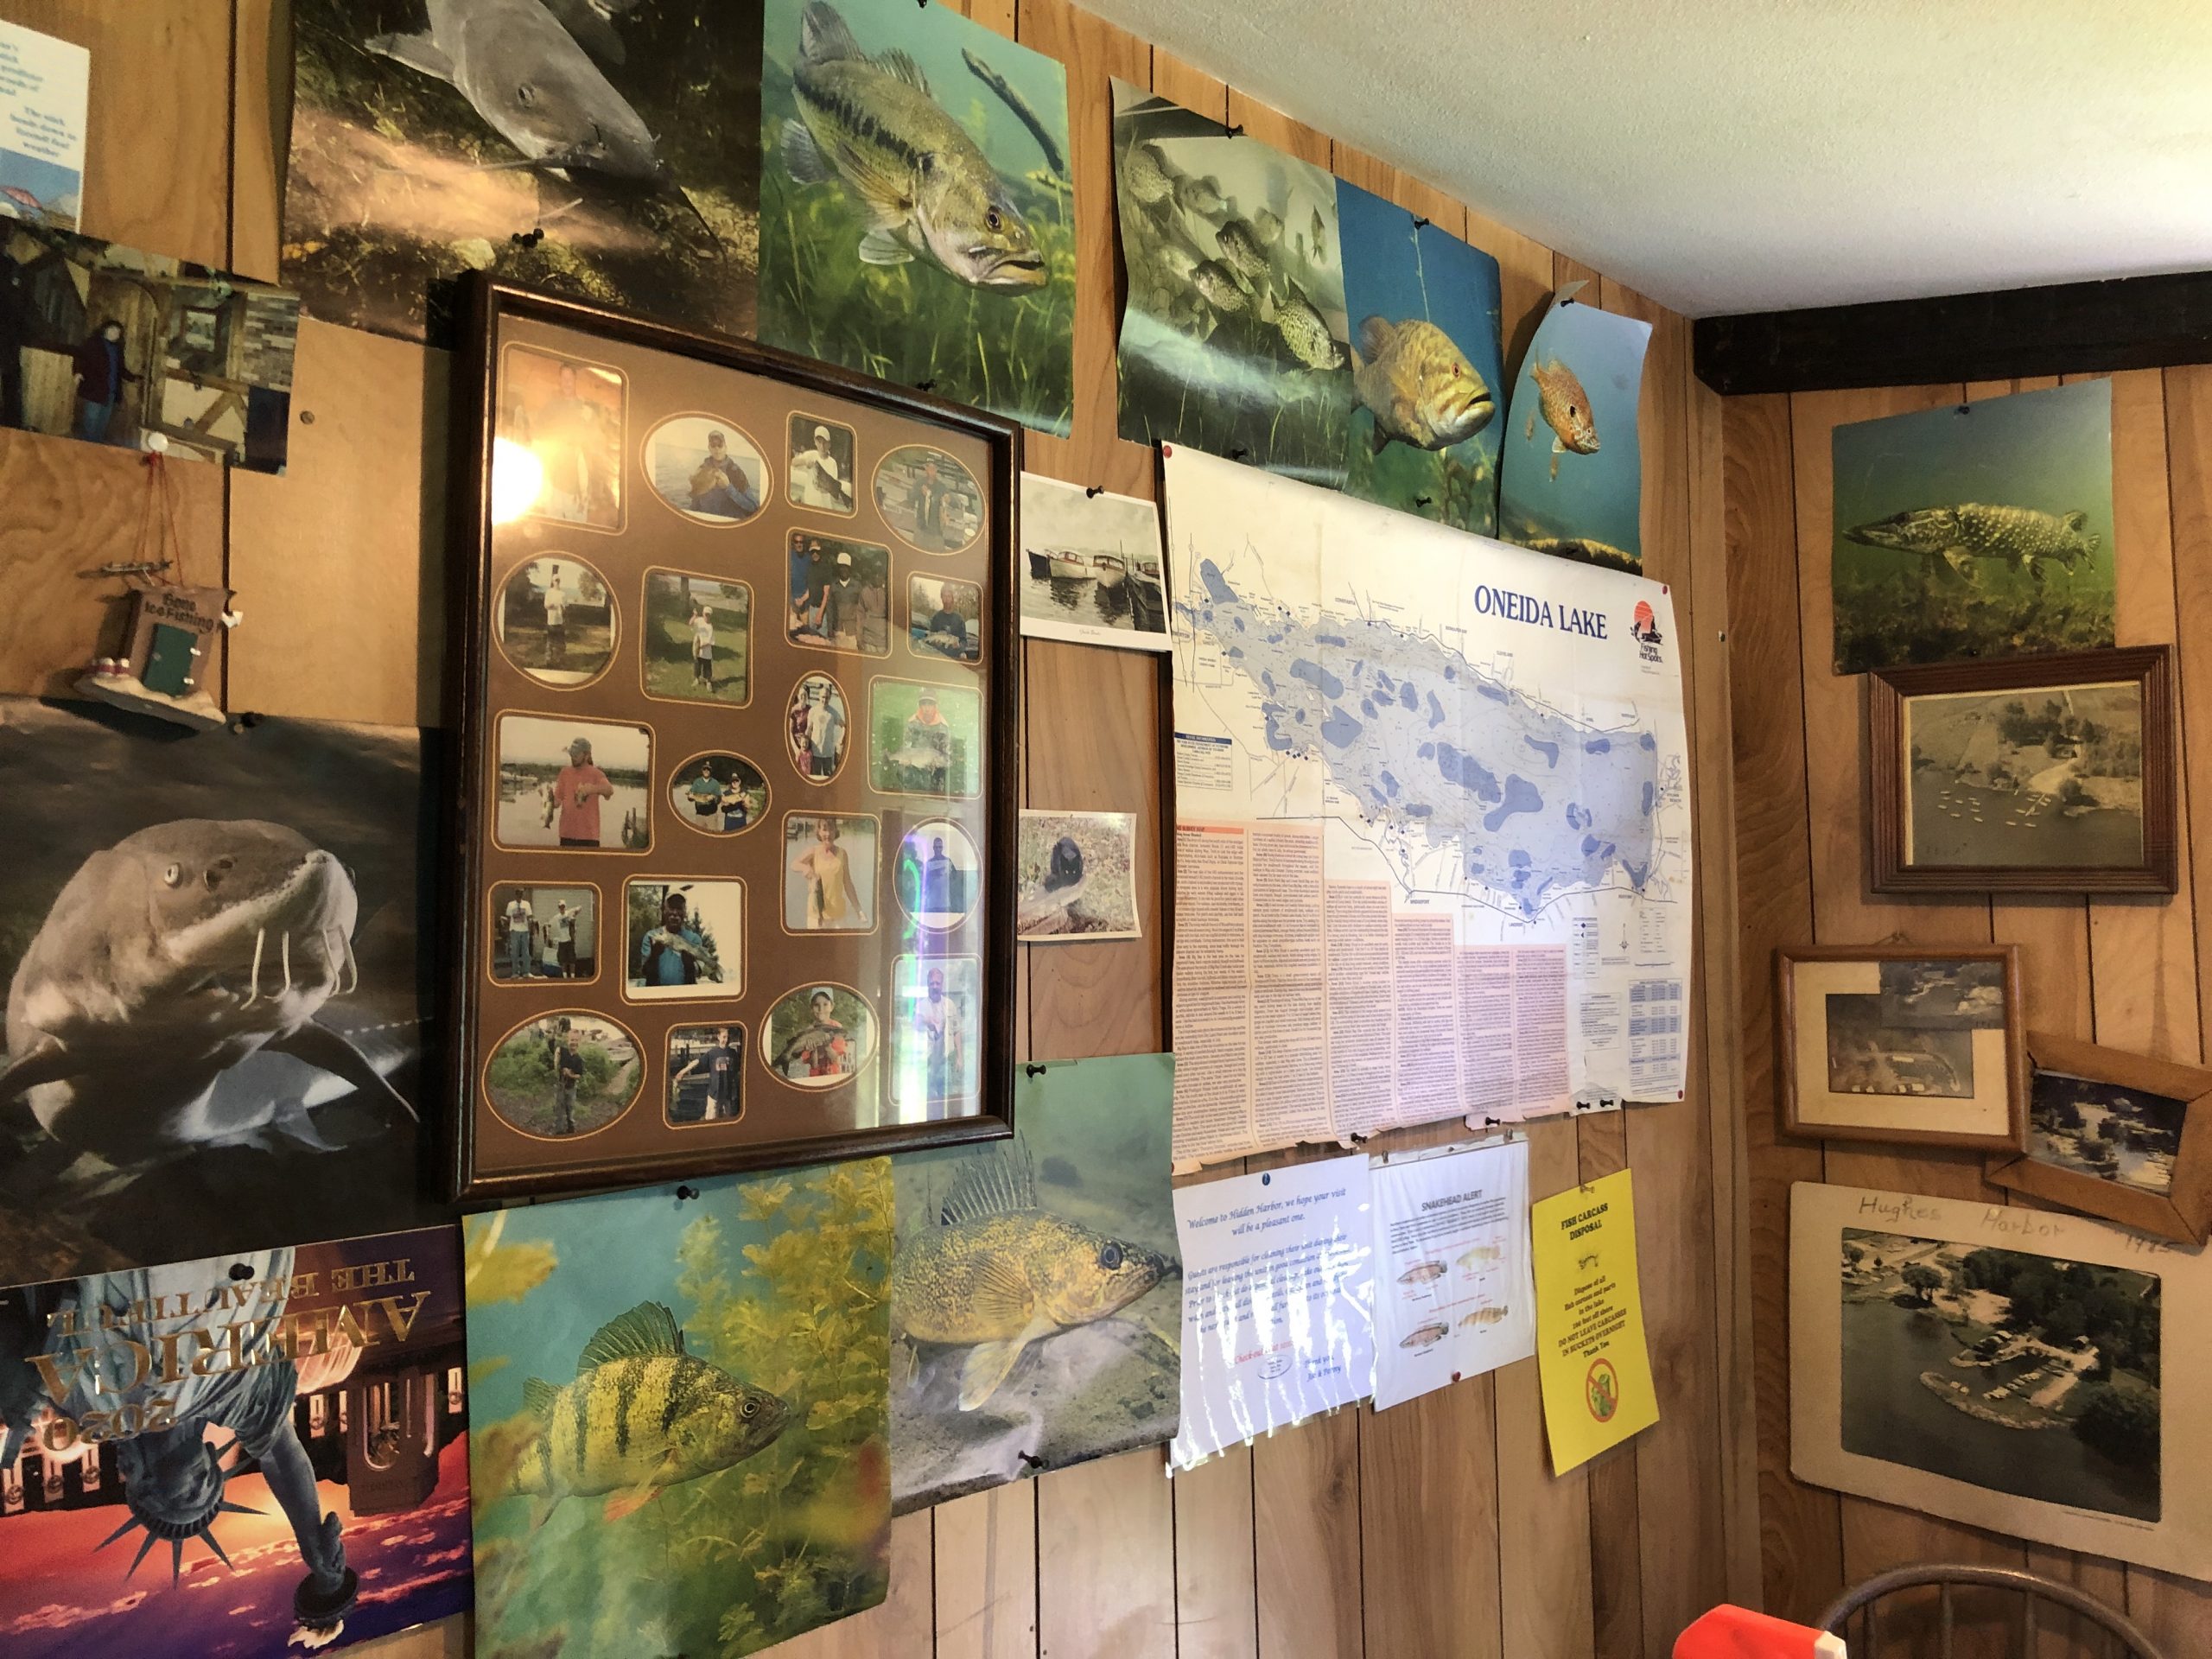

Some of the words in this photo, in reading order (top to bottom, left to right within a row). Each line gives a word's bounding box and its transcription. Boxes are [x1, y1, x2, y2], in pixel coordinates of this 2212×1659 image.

[166, 607, 214, 633] Fishing
[1474, 585, 1554, 628] ONEIDA
[1559, 605, 1608, 640] LAKE
[1187, 1217, 1218, 1230] Welcome
[1220, 1214, 1228, 1223] to
[1228, 1208, 1255, 1221] Hidden
[1255, 1201, 1283, 1214] Harbor,
[1296, 1194, 1312, 1207] hope
[1313, 1192, 1329, 1204] your
[1332, 1188, 1346, 1198] visit
[1421, 1194, 1462, 1211] SNAKEHEAD
[1463, 1189, 1483, 1202] ALERT
[1231, 1224, 1245, 1236] will
[1246, 1223, 1255, 1232] be
[1255, 1222, 1260, 1230] a
[1261, 1215, 1289, 1232] pleasant
[1291, 1212, 1306, 1222] one.
[1560, 1216, 1577, 1230] FISH
[1578, 1203, 1609, 1223] CARCASS
[1569, 1220, 1602, 1241] DISPOSAL
[1858, 1194, 1943, 1223] Hughes
[1980, 1207, 2066, 1238] Harbor
[331, 1258, 416, 1293] THE
[47, 1272, 321, 1338] BEAUTIFUL
[24, 1290, 432, 1406] AMERICA
[1567, 1332, 1579, 1343] NOT
[1580, 1323, 1597, 1337] LEAVE
[1583, 1345, 1599, 1357] Thank
[43, 1398, 176, 1452] 2020
